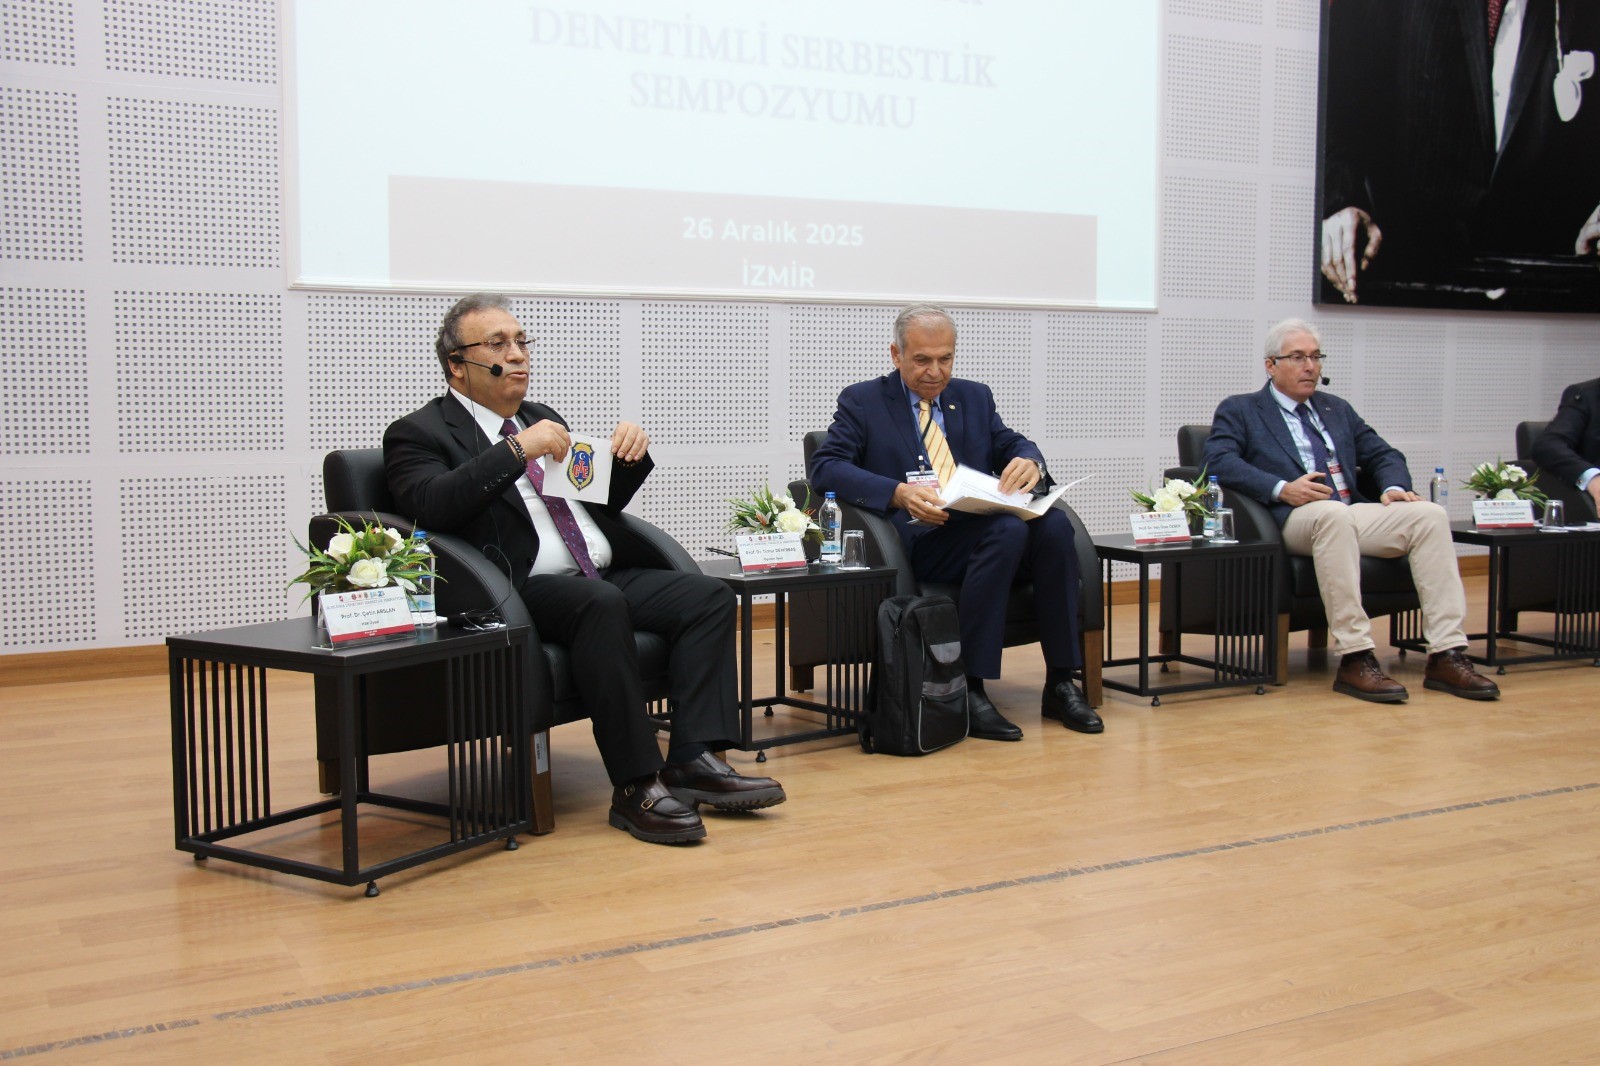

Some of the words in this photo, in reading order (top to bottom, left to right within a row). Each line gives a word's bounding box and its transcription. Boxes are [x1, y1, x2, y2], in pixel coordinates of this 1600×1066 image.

[528, 6, 770, 67] DENETİMLİ
[781, 32, 998, 90] SERBESTLİK
[629, 71, 919, 130] SEMPOZYUMU
[682, 216, 714, 241] 26
[721, 218, 798, 244] Aralık
[805, 223, 865, 247] 2025
[742, 258, 816, 288] İZMİR
